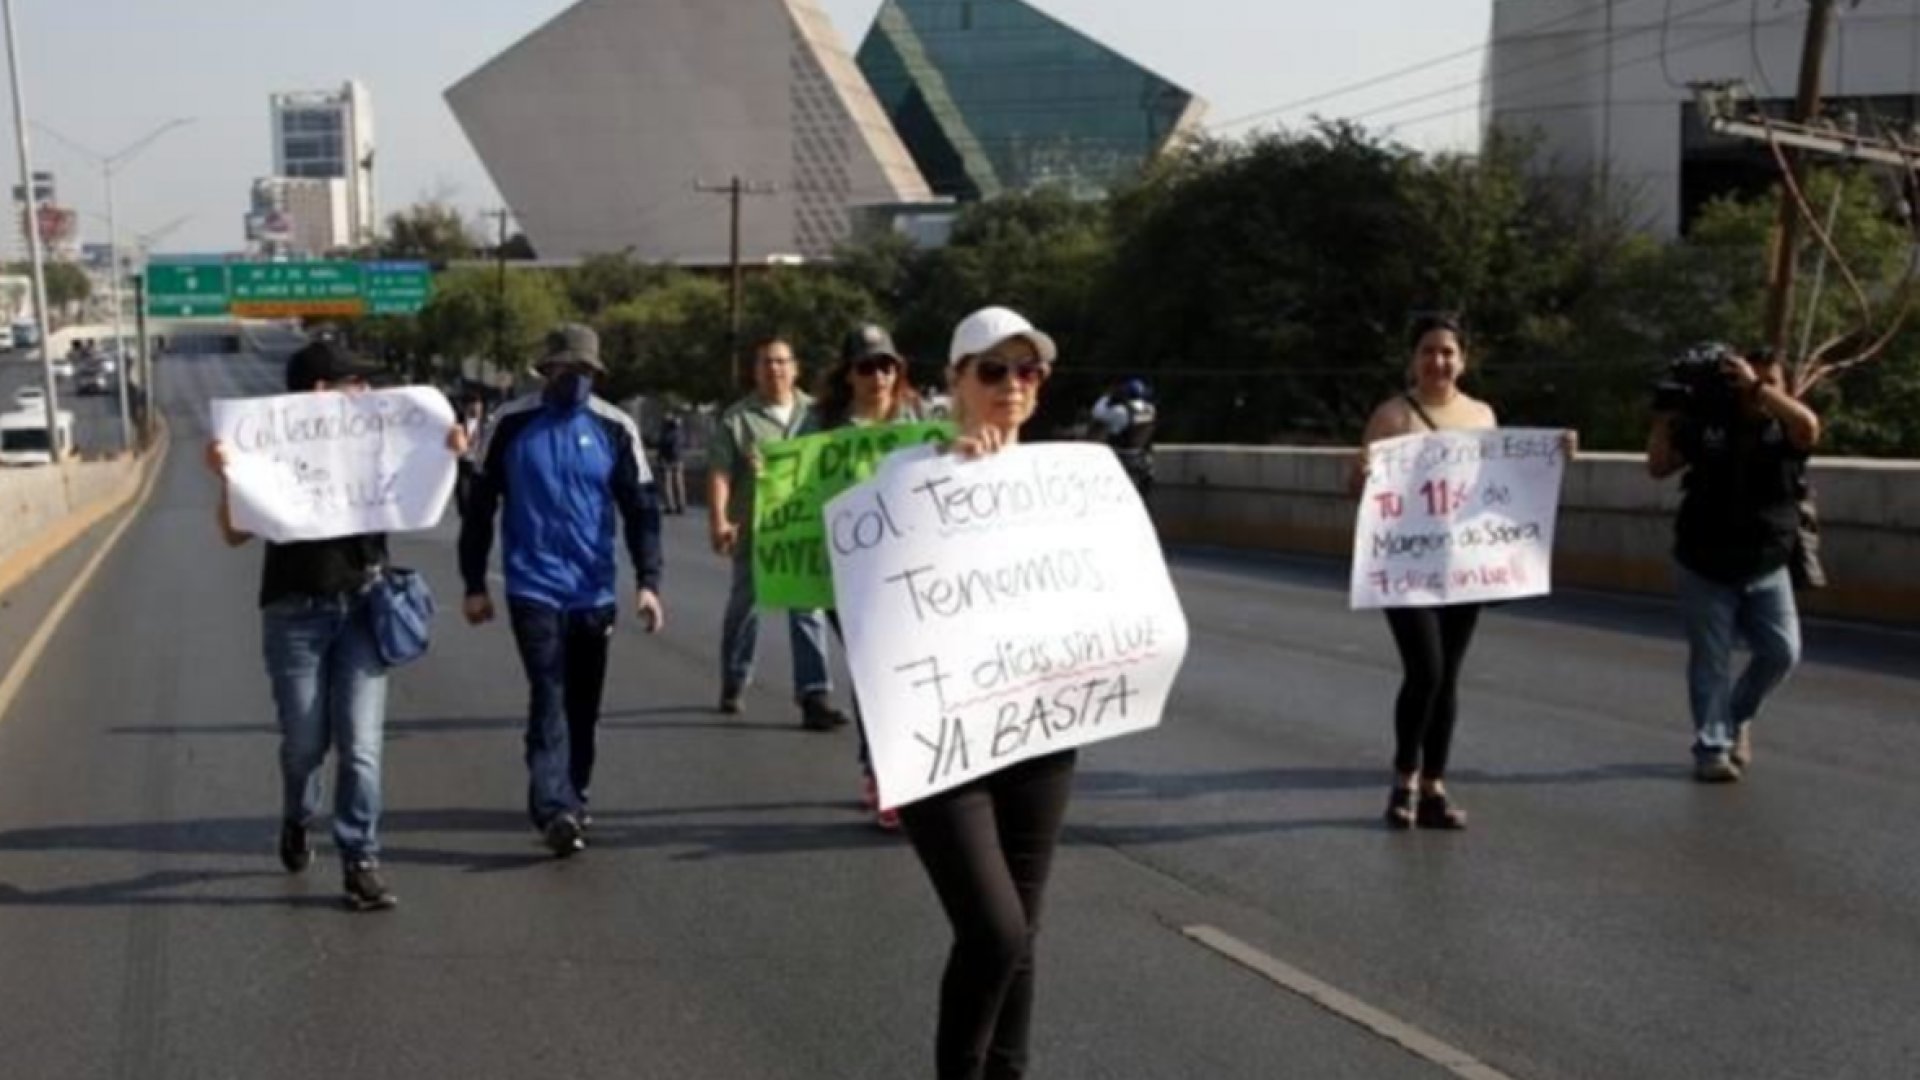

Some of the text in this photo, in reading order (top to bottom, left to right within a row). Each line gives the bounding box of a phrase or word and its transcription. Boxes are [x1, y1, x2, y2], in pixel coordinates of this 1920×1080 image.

[894, 655, 952, 711] 7
[913, 673, 1141, 786] YA BASTA
